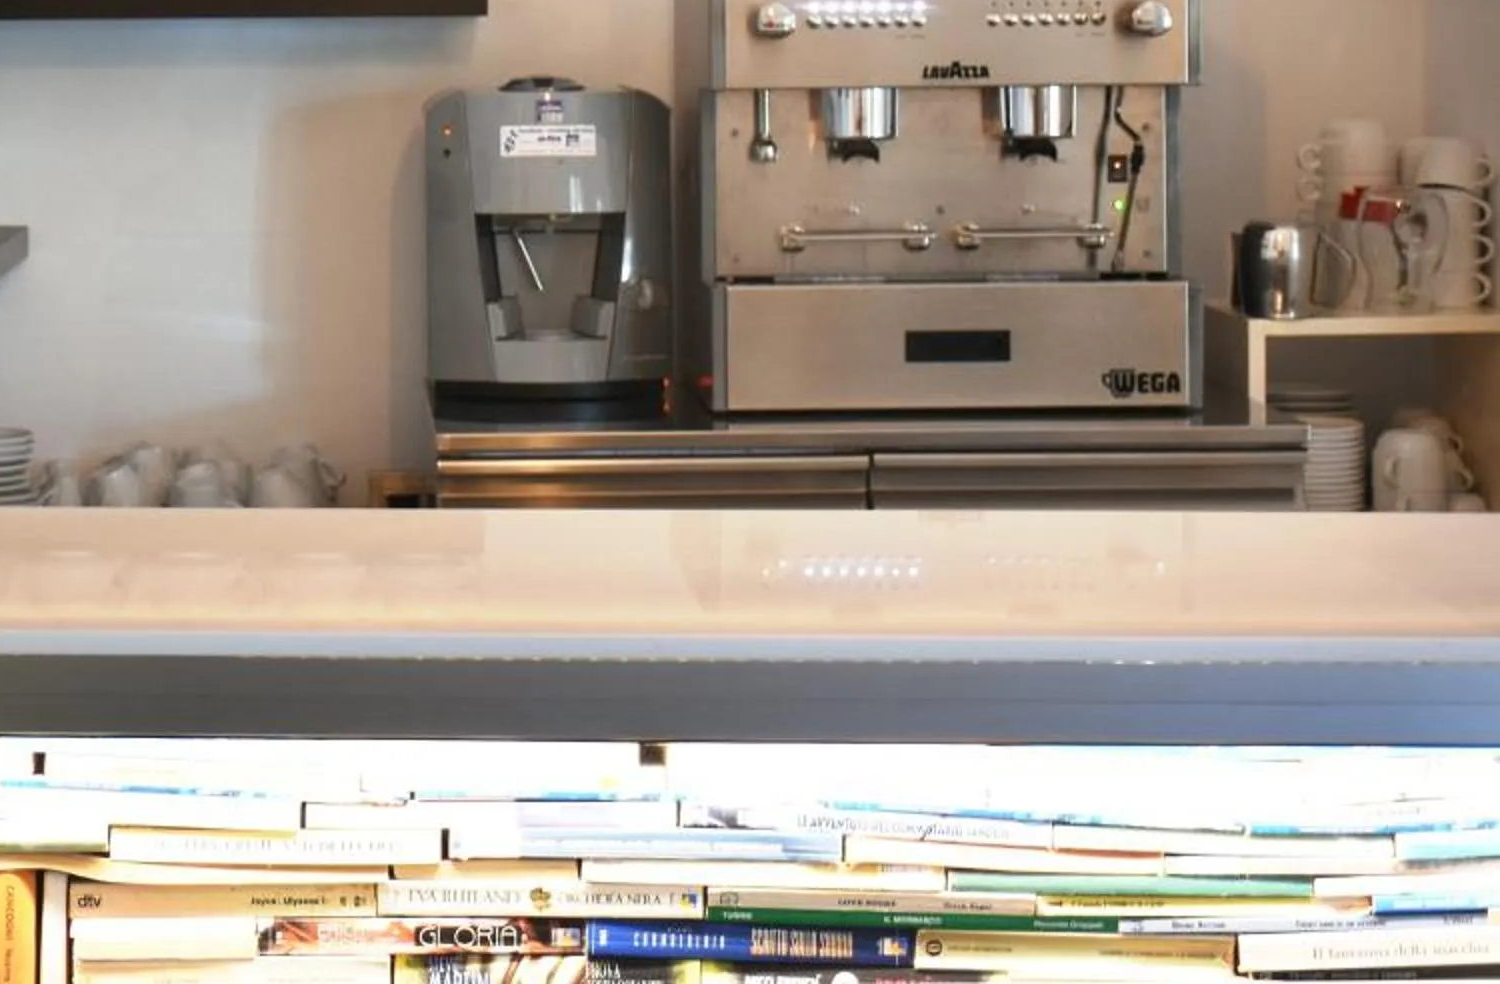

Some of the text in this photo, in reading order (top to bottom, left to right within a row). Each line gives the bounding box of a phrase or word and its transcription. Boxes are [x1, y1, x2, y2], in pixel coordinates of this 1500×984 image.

[922, 60, 989, 79] LAVAZZA
[1111, 370, 1181, 394] WEGA
[77, 894, 102, 909] dtv
[419, 925, 518, 947] GLORIA
